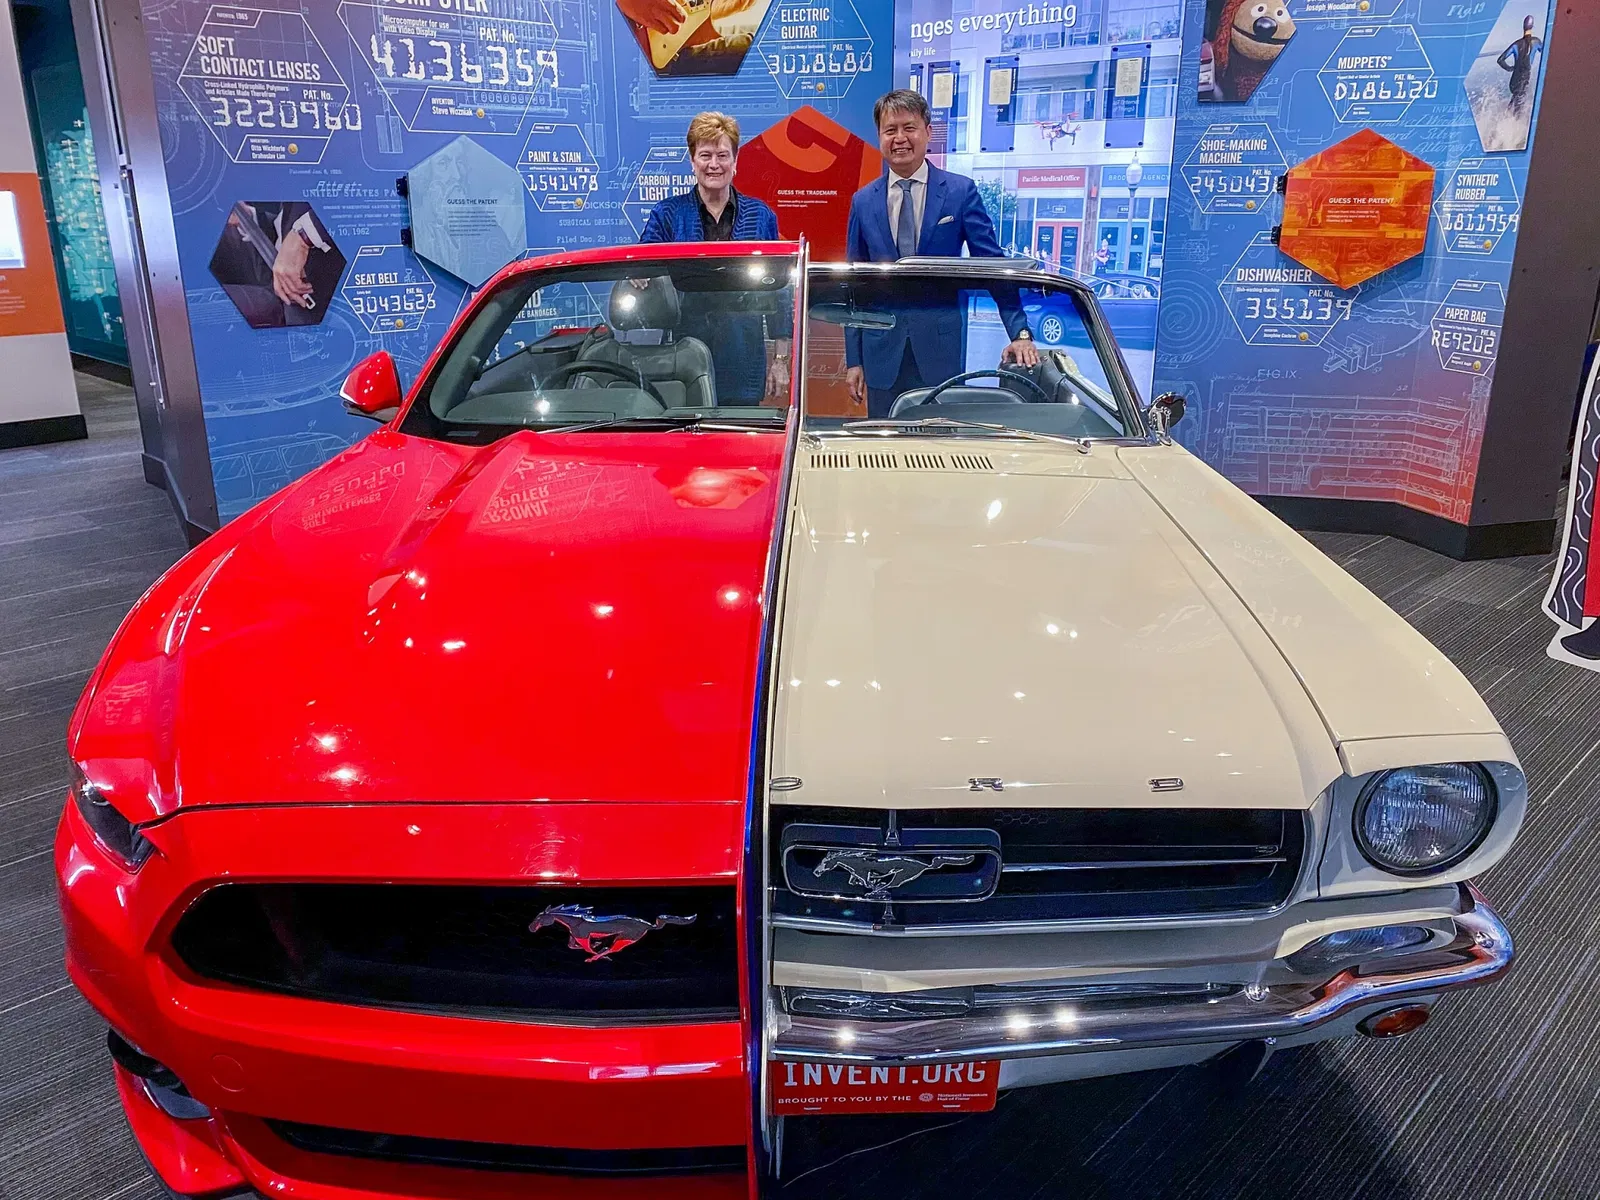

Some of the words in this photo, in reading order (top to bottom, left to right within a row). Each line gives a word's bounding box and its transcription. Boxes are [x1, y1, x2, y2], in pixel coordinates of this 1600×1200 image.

[382, 14, 428, 27] Microcomputer
[781, 8, 830, 22] ELECTRIC
[911, 19, 954, 42] nges
[960, 3, 1077, 34] everything
[384, 24, 398, 33] with
[399, 26, 415, 34] Video
[416, 27, 437, 38] Display
[479, 27, 499, 41] PAT.
[502, 29, 517, 43] No.
[781, 25, 817, 39] GUITAR
[198, 35, 234, 56] SOFT
[924, 47, 936, 56] life
[370, 34, 558, 88] 4136359
[768, 52, 873, 74] 3018680
[200, 56, 264, 77] CONTACT
[268, 60, 321, 81] LENSES
[303, 90, 319, 100] PAT.
[321, 91, 333, 101] No.
[1334, 80, 1438, 100] D186120
[210, 97, 362, 130] 3220960
[432, 105, 448, 115] Steve
[450, 107, 473, 116] Wozniak
[1201, 139, 1267, 151] SHOE-MAKING
[528, 151, 550, 162] PAINT
[552, 152, 559, 163] &
[560, 151, 581, 163] STAIN
[1199, 152, 1243, 164] MACHINE
[528, 174, 598, 191] 1541478
[639, 175, 669, 186] CARBON
[672, 175, 698, 185] FILAM
[1022, 175, 1039, 183] Pacific
[1041, 174, 1063, 182] Medical
[1064, 174, 1080, 182] Office
[1457, 173, 1499, 186] SYNTHETIC
[303, 189, 338, 198] UNITED
[344, 189, 379, 197] STATES
[640, 187, 670, 201] LIGHT
[1455, 188, 1486, 200] RUBBER
[585, 201, 624, 209] DICKSON
[1443, 213, 1519, 233] 1811959
[339, 228, 350, 237] 10,
[353, 228, 370, 236] 1962
[556, 236, 577, 244] Filed
[354, 273, 376, 285] SEAT
[378, 272, 398, 284] BELT
[1237, 268, 1313, 282] DISHWASHER
[1309, 289, 1322, 298] PAT.
[1324, 290, 1335, 298] No.
[353, 293, 436, 314] 3043625
[1245, 297, 1352, 320] 355139
[526, 308, 557, 318] BANDAGES
[1444, 307, 1469, 321] PAPER
[1470, 310, 1487, 323] BAG
[1431, 330, 1495, 354] RE9202
[784, 1061, 987, 1086] INVENT.ORG
